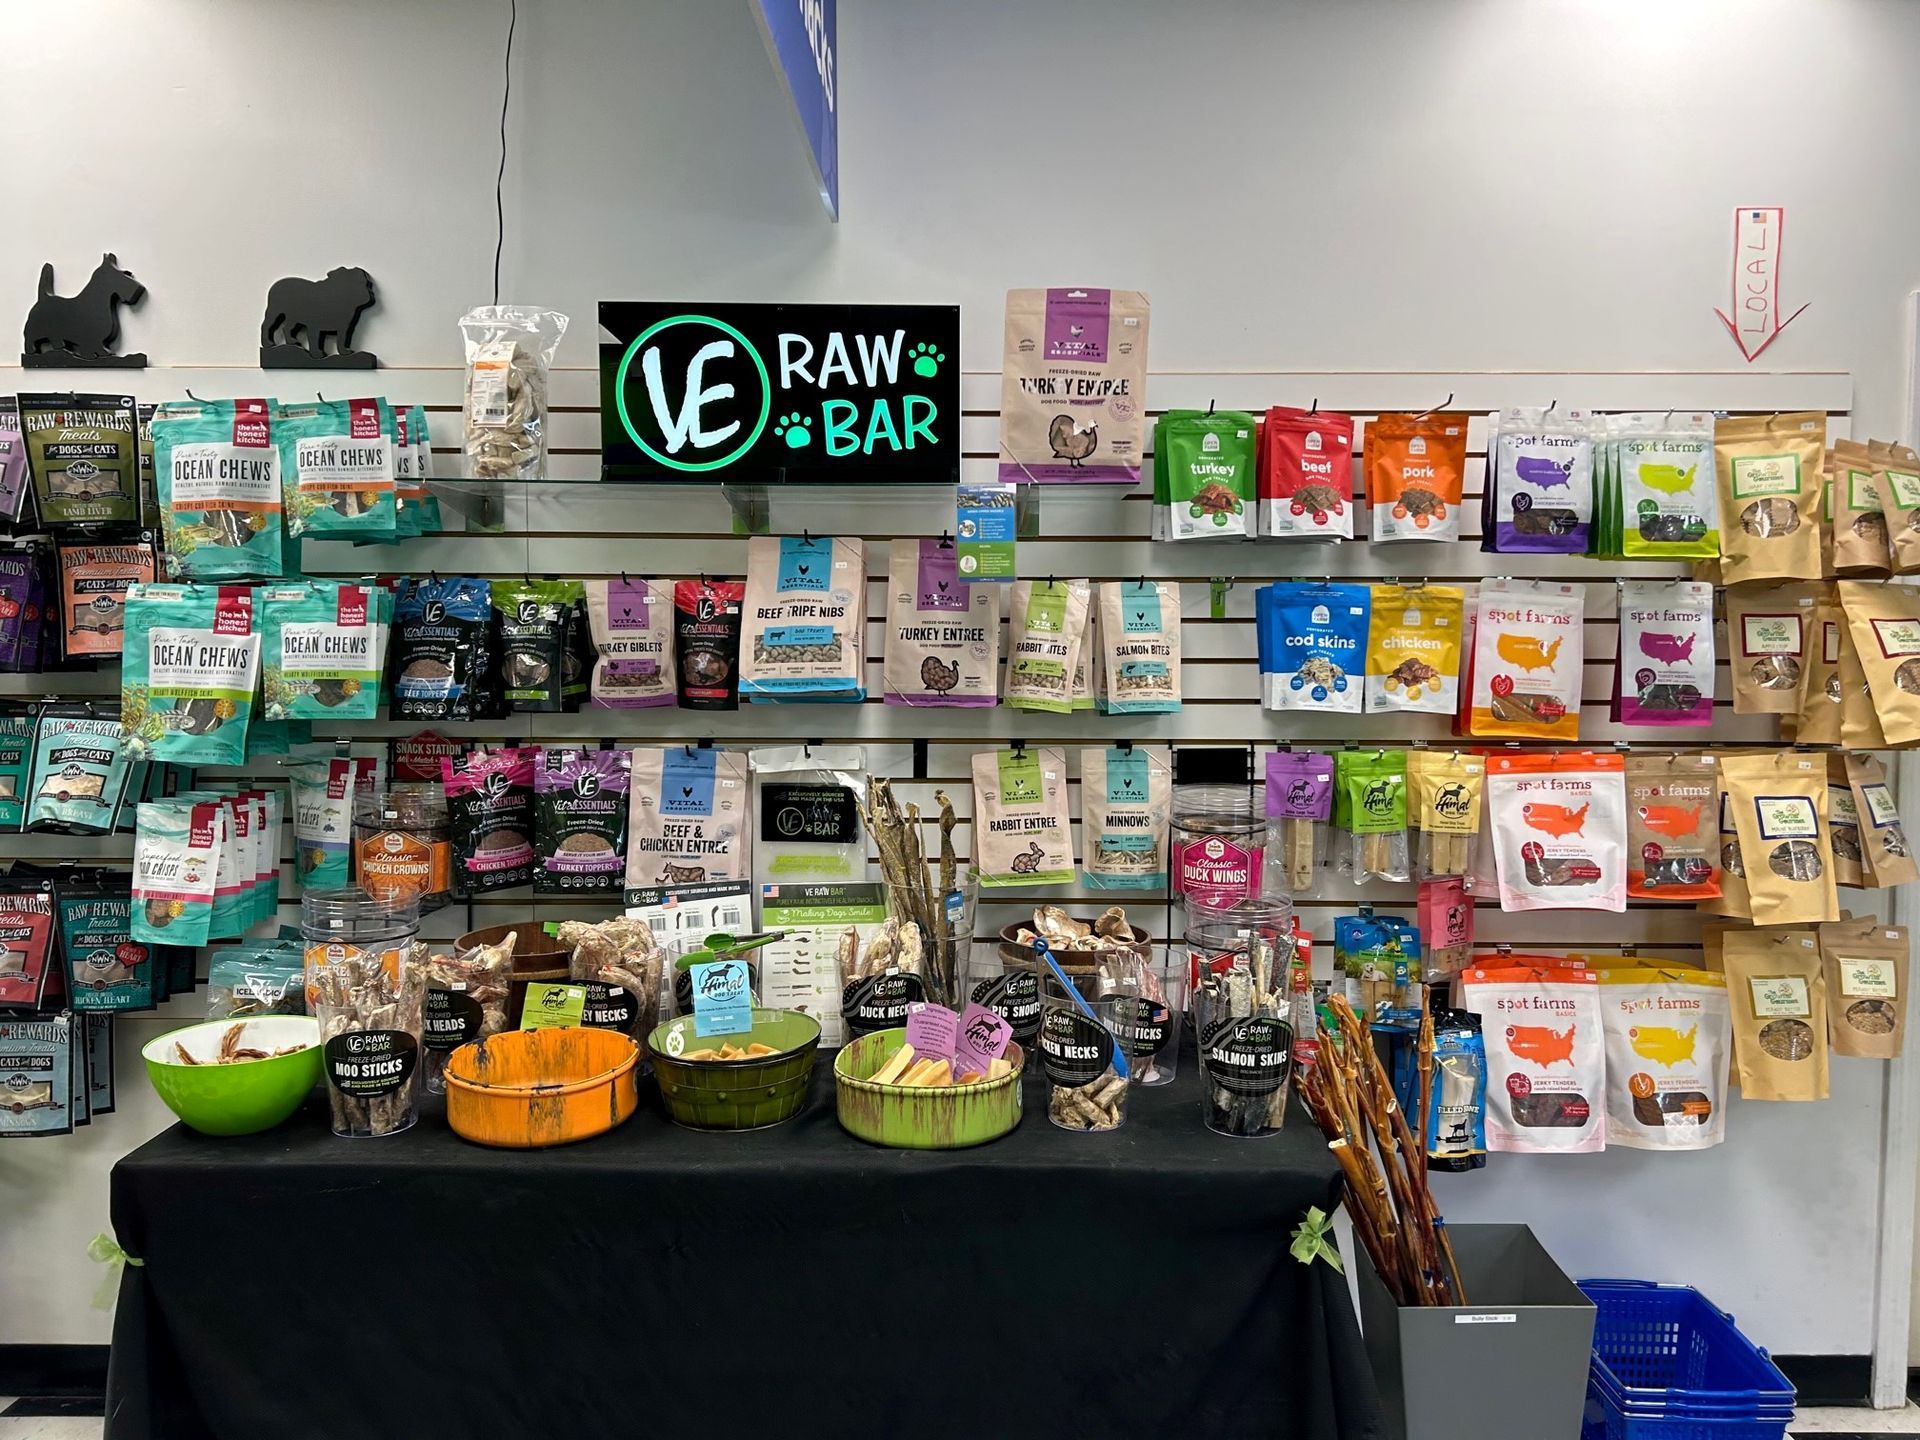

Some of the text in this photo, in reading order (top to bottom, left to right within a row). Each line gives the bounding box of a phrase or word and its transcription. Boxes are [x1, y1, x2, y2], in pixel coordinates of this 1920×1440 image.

[1744, 228, 1768, 333] LOCAL
[1053, 341, 1099, 350] VITAL
[1049, 368, 1087, 376] FREEZE-DRIED
[642, 329, 905, 454] VE RAW
[27, 413, 56, 432] RAW
[64, 411, 132, 433] REWARDS
[822, 394, 939, 457] BAR
[58, 429, 102, 441] Treats
[1508, 435, 1537, 448] pot
[59, 445, 116, 455] DOGS CATS
[1628, 441, 1703, 453] spot farms
[300, 448, 383, 467] OCEAN CHEWS
[175, 459, 271, 481] OCEAN CHEWS
[1190, 462, 1235, 477] turkey
[1301, 458, 1332, 473] beef
[1403, 465, 1435, 479] pork
[64, 548, 152, 568] RAW REWARDS
[86, 580, 105, 589] CATS
[93, 600, 114, 608] NWN
[757, 607, 844, 619] BEEF NIBS
[1488, 610, 1521, 623] spot
[1630, 609, 1701, 623] spot farms
[218, 618, 247, 626] honest
[899, 627, 984, 641] TURKEY ENTREE
[285, 637, 367, 653] OCEAN CHEWS
[630, 642, 662, 652] GIBLETS
[1016, 642, 1042, 653] RABBIT
[1286, 634, 1356, 649] cod skins
[1382, 636, 1441, 650] chicken
[1116, 644, 1170, 656] SALMON BITES
[154, 645, 248, 669] OCEAN CHEWS
[404, 689, 419, 697] BEEF
[42, 721, 67, 739] RAW
[64, 734, 101, 747] Treats
[61, 749, 111, 760] DOGS CATS
[396, 743, 461, 755] SNACK STATION
[1633, 785, 1710, 798] spot farms
[1287, 792, 1314, 805] Himal
[1435, 797, 1471, 815] Himal
[990, 816, 1057, 832] RABBIT ENTREE
[1105, 816, 1150, 827] MINNOWS
[663, 825, 703, 839] BEEF &
[814, 821, 840, 836] BAR
[640, 838, 728, 854] CHICKEN ENTREE
[140, 848, 182, 864] Superfood
[374, 852, 413, 862] Classic
[152, 862, 179, 876] CRISPS
[363, 861, 429, 875] CHICKEN CROWNS
[476, 861, 506, 871] CHICKEN
[557, 863, 614, 871] TURKEY TOPPERS
[1197, 858, 1233, 868] Classic
[1185, 865, 1247, 882] DUCK WINGS
[805, 888, 813, 896] VE
[68, 903, 89, 921] RAW
[791, 907, 847, 919] Making Dogs
[88, 917, 119, 929] Treats
[13, 928, 31, 936] CATS
[83, 935, 102, 944] DOGS
[701, 974, 743, 994] Himal
[104, 995, 130, 1003] HEART
[428, 992, 444, 1000] RAW
[1658, 996, 1700, 1009] farms
[1013, 1002, 1040, 1016] SNOUTS
[1497, 996, 1576, 1013] spot farms
[595, 1008, 628, 1022] NECKS
[860, 1005, 884, 1018] DUCK
[434, 1018, 466, 1031] HEADS
[1053, 1014, 1070, 1025] RAW
[8, 1024, 68, 1045] REWARDS
[1250, 1026, 1268, 1034] RAW
[365, 1034, 386, 1043] RAW
[1255, 1033, 1272, 1042] BAR
[371, 1042, 390, 1051] BAR
[1064, 1045, 1099, 1059] NECKS
[31, 1058, 51, 1066] DOGS
[347, 1054, 391, 1064] FREEZE-DRIED
[1212, 1047, 1287, 1067] SALMON SKINS
[335, 1059, 402, 1077] MOO STICKS
